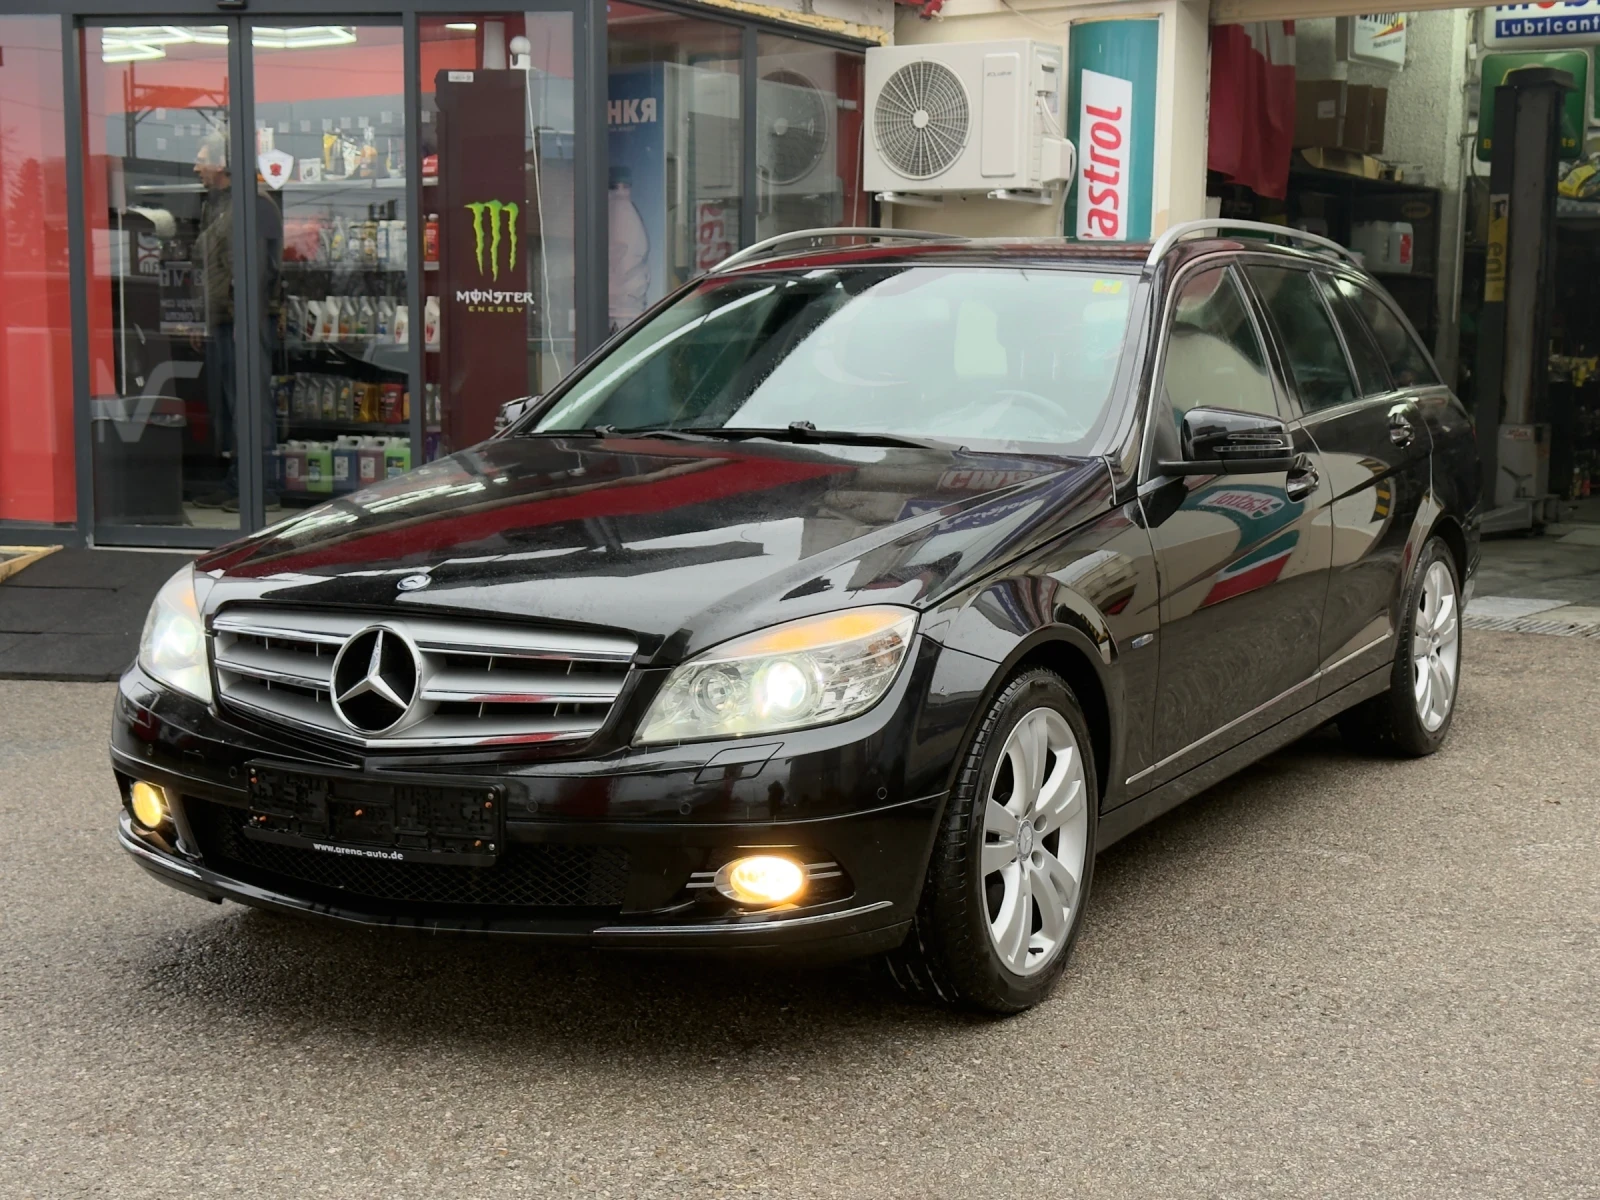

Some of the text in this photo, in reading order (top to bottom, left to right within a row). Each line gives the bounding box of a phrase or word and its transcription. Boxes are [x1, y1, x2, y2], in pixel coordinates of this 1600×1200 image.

[1083, 104, 1122, 239] astrol
[456, 288, 535, 305] MONSTER
[468, 305, 523, 313] ENERGY
[312, 843, 404, 859] www.arena-auto.de
